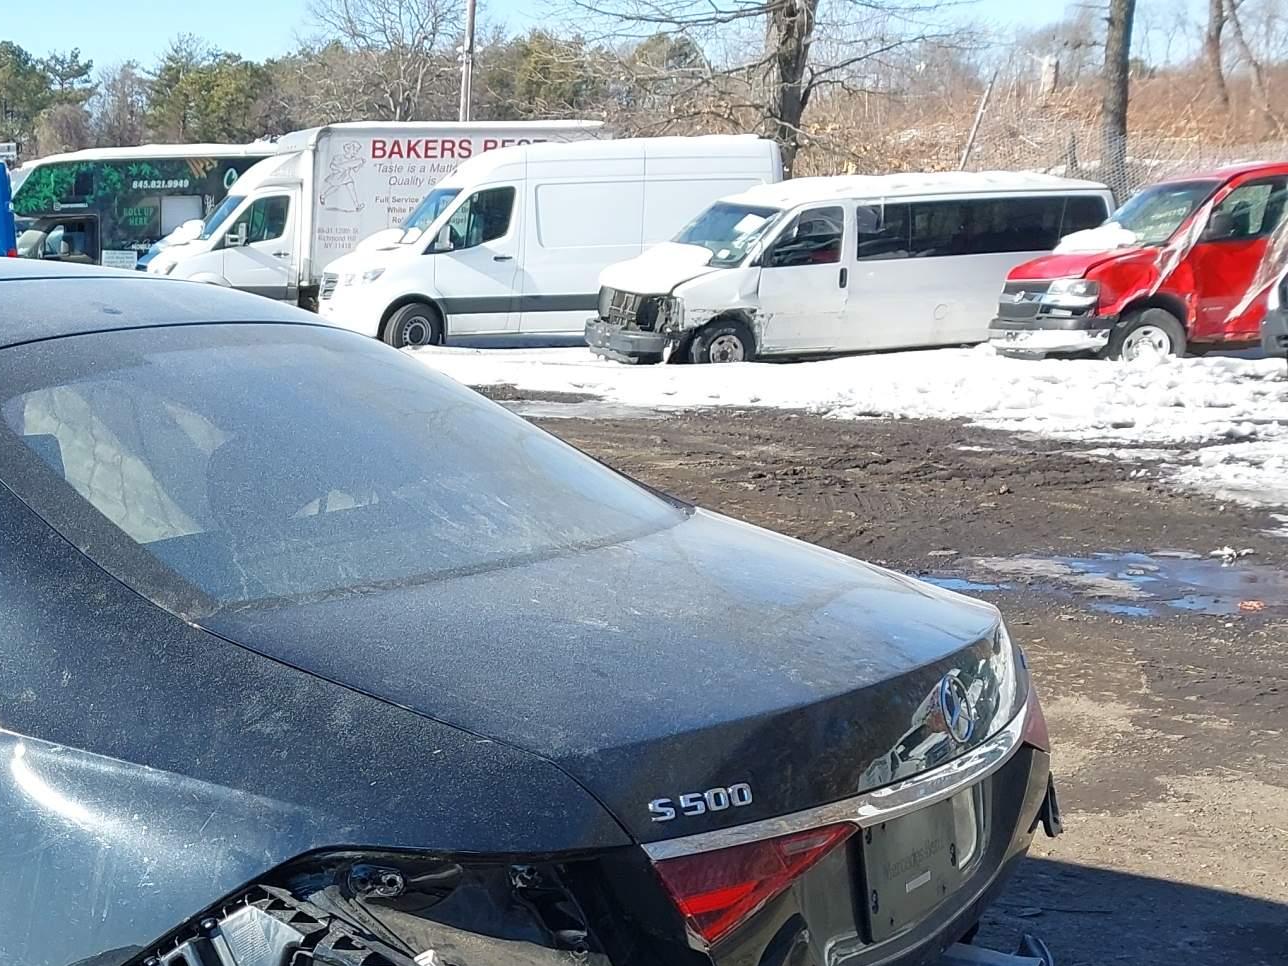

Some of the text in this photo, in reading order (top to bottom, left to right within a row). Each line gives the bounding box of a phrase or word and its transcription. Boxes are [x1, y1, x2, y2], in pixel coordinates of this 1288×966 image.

[372, 139, 472, 159] BAKERS
[408, 163, 415, 173] is
[419, 165, 426, 173] a
[389, 176, 436, 187] Quality is
[648, 783, 753, 821] S 500
